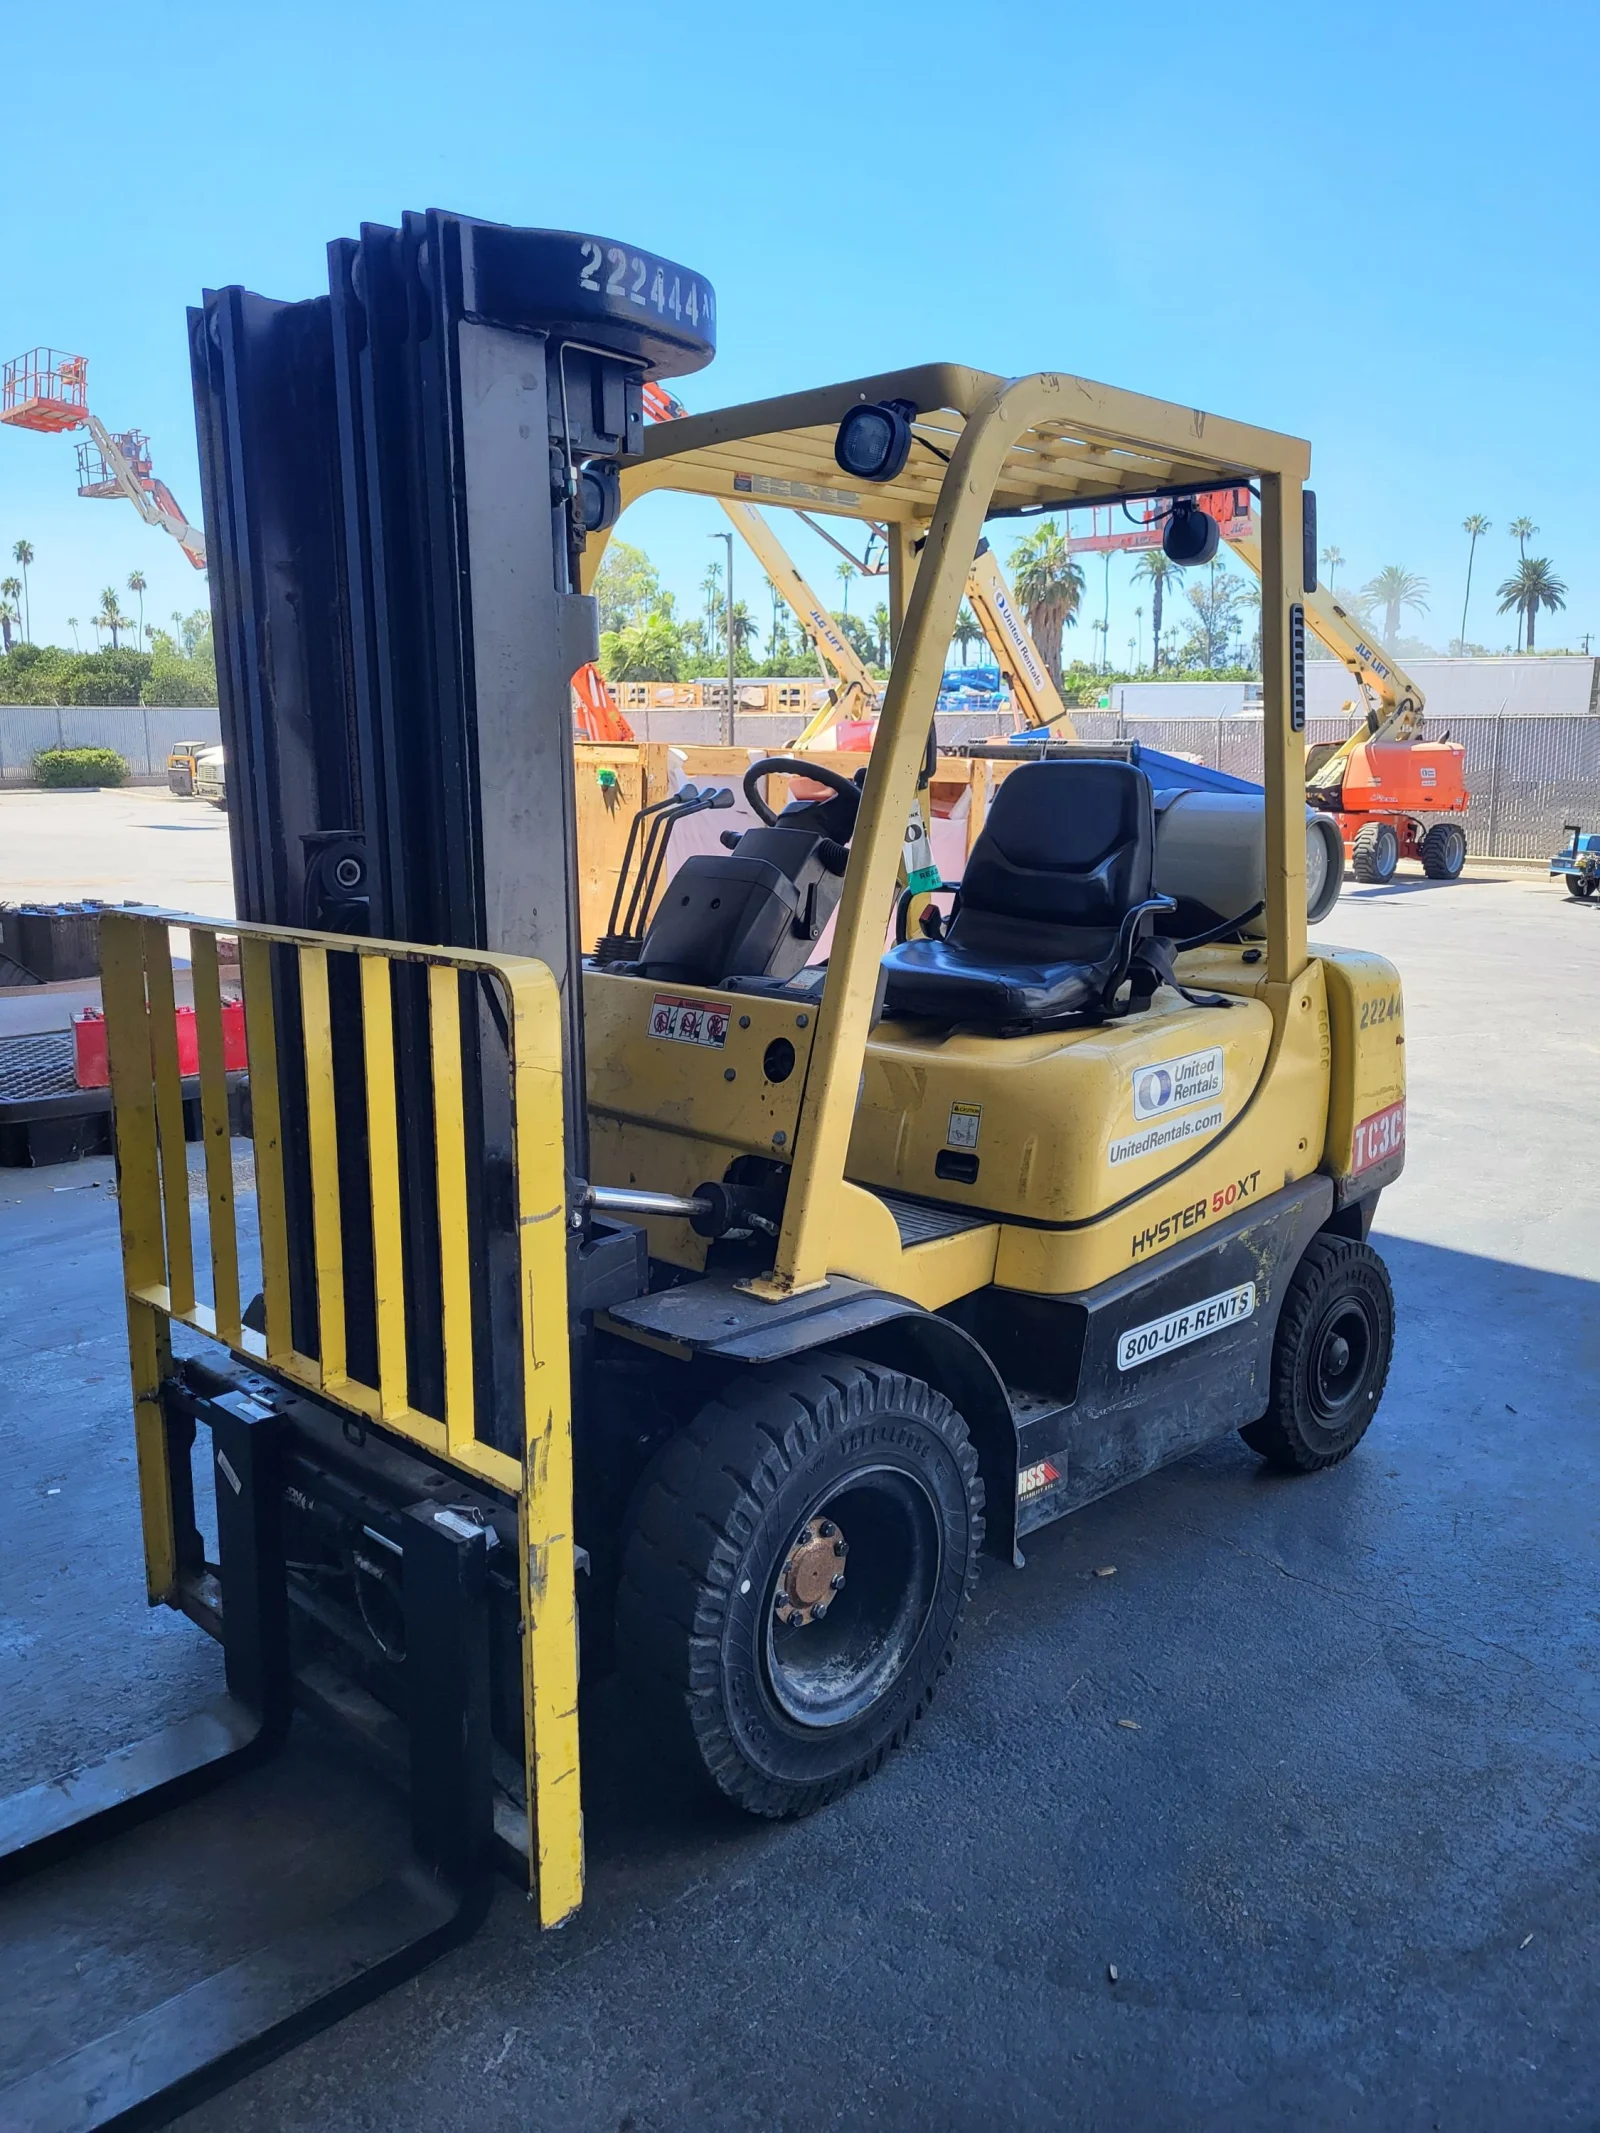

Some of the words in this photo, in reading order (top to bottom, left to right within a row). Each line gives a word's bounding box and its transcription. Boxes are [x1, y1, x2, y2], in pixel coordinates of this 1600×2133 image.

[810, 611, 827, 628] JLG
[825, 631, 844, 652] LIFT
[1003, 609, 1024, 646] United
[1020, 647, 1041, 686] Rentals
[1355, 643, 1372, 661] JLG
[1371, 657, 1390, 679] LIFT
[1174, 1075, 1219, 1101] Rentals
[1175, 1055, 1216, 1082] United
[1110, 1112, 1222, 1163] UnitedRentals.com
[1355, 1103, 1406, 1167] TC3C
[1131, 1199, 1207, 1258] HYSTER
[1212, 1170, 1261, 1213] 50XT
[1125, 1292, 1249, 1360] 800-UR-RENTS
[1018, 1463, 1046, 1496] HSS
